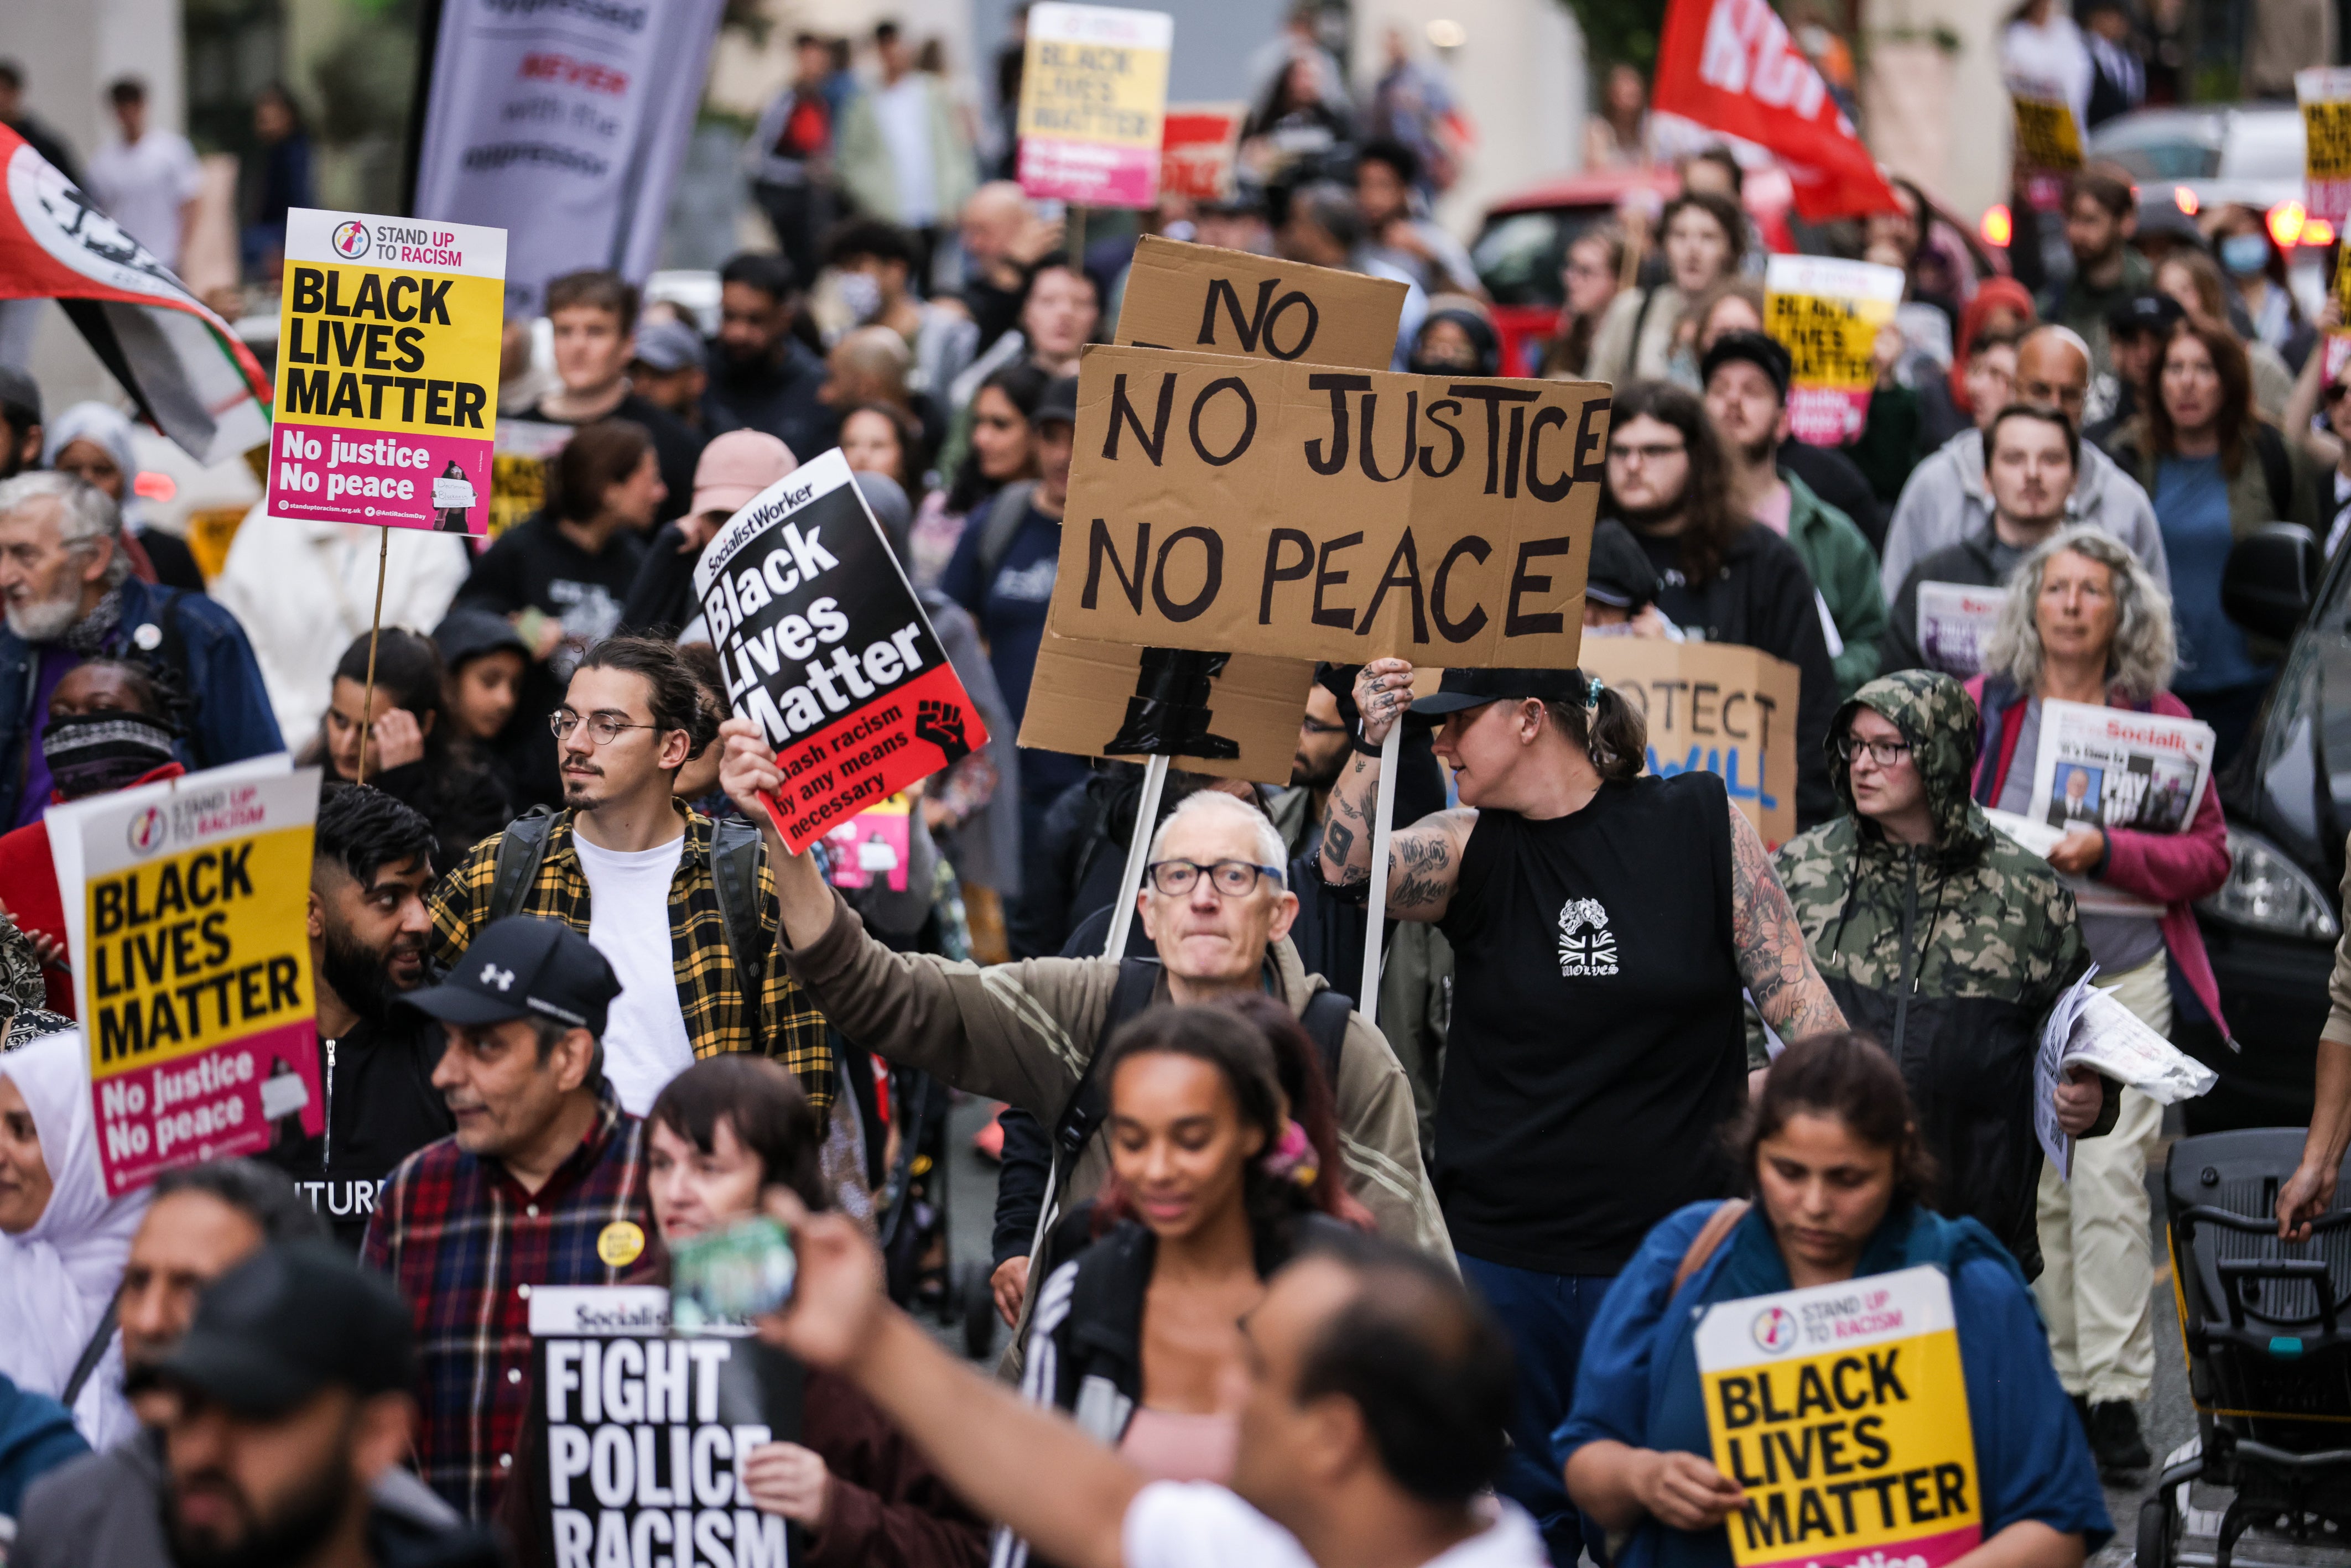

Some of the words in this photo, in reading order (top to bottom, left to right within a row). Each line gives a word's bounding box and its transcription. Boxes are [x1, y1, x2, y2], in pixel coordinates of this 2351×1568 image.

[376, 244, 397, 261] TO
[401, 246, 462, 267] RACISM
[377, 226, 428, 245] STAND
[433, 231, 454, 247] UP
[292, 267, 454, 325] BLACK
[1197, 278, 1319, 361] NO
[289, 317, 425, 373] LIVES
[285, 368, 486, 429] MATTER
[282, 430, 322, 460] No
[327, 434, 429, 469] justice
[1102, 372, 1257, 467] NO
[1304, 372, 1611, 503] JUSTICE
[279, 462, 320, 492] No
[327, 473, 414, 501] peace
[290, 503, 361, 514] standuptoracism.org.uk
[376, 510, 426, 520] @AntiRacismDay
[709, 515, 756, 576] Socialist
[753, 482, 813, 528] Worker
[704, 522, 839, 653] Black
[1080, 518, 1224, 623] NO
[1258, 525, 1570, 644] PEACE
[719, 597, 849, 699] Lives
[732, 621, 924, 744] Matter
[831, 702, 903, 753] racism
[172, 791, 226, 816] STAND
[230, 786, 257, 808] UP
[773, 794, 795, 817] by
[800, 770, 834, 801] any
[839, 729, 909, 777] means
[788, 771, 886, 841] necessary
[173, 817, 194, 841] TO
[197, 805, 266, 835] RACISM
[93, 841, 254, 938] BLACK
[95, 911, 231, 999] LIVES
[98, 955, 301, 1062] MATTER
[101, 1080, 146, 1121] No
[151, 1050, 254, 1114] justice
[106, 1116, 149, 1162] No
[155, 1096, 245, 1156] peace
[1802, 1295, 1861, 1321] STAND
[1865, 1289, 1890, 1311] UP
[1806, 1323, 1829, 1344] TO
[1835, 1310, 1904, 1338] RACISM
[546, 1338, 731, 1425] FIGHT
[1719, 1348, 1908, 1430] BLACK
[1728, 1416, 1891, 1489] LIVES
[552, 1508, 789, 1568] RACISM
[1740, 1462, 1970, 1550] MATTER
